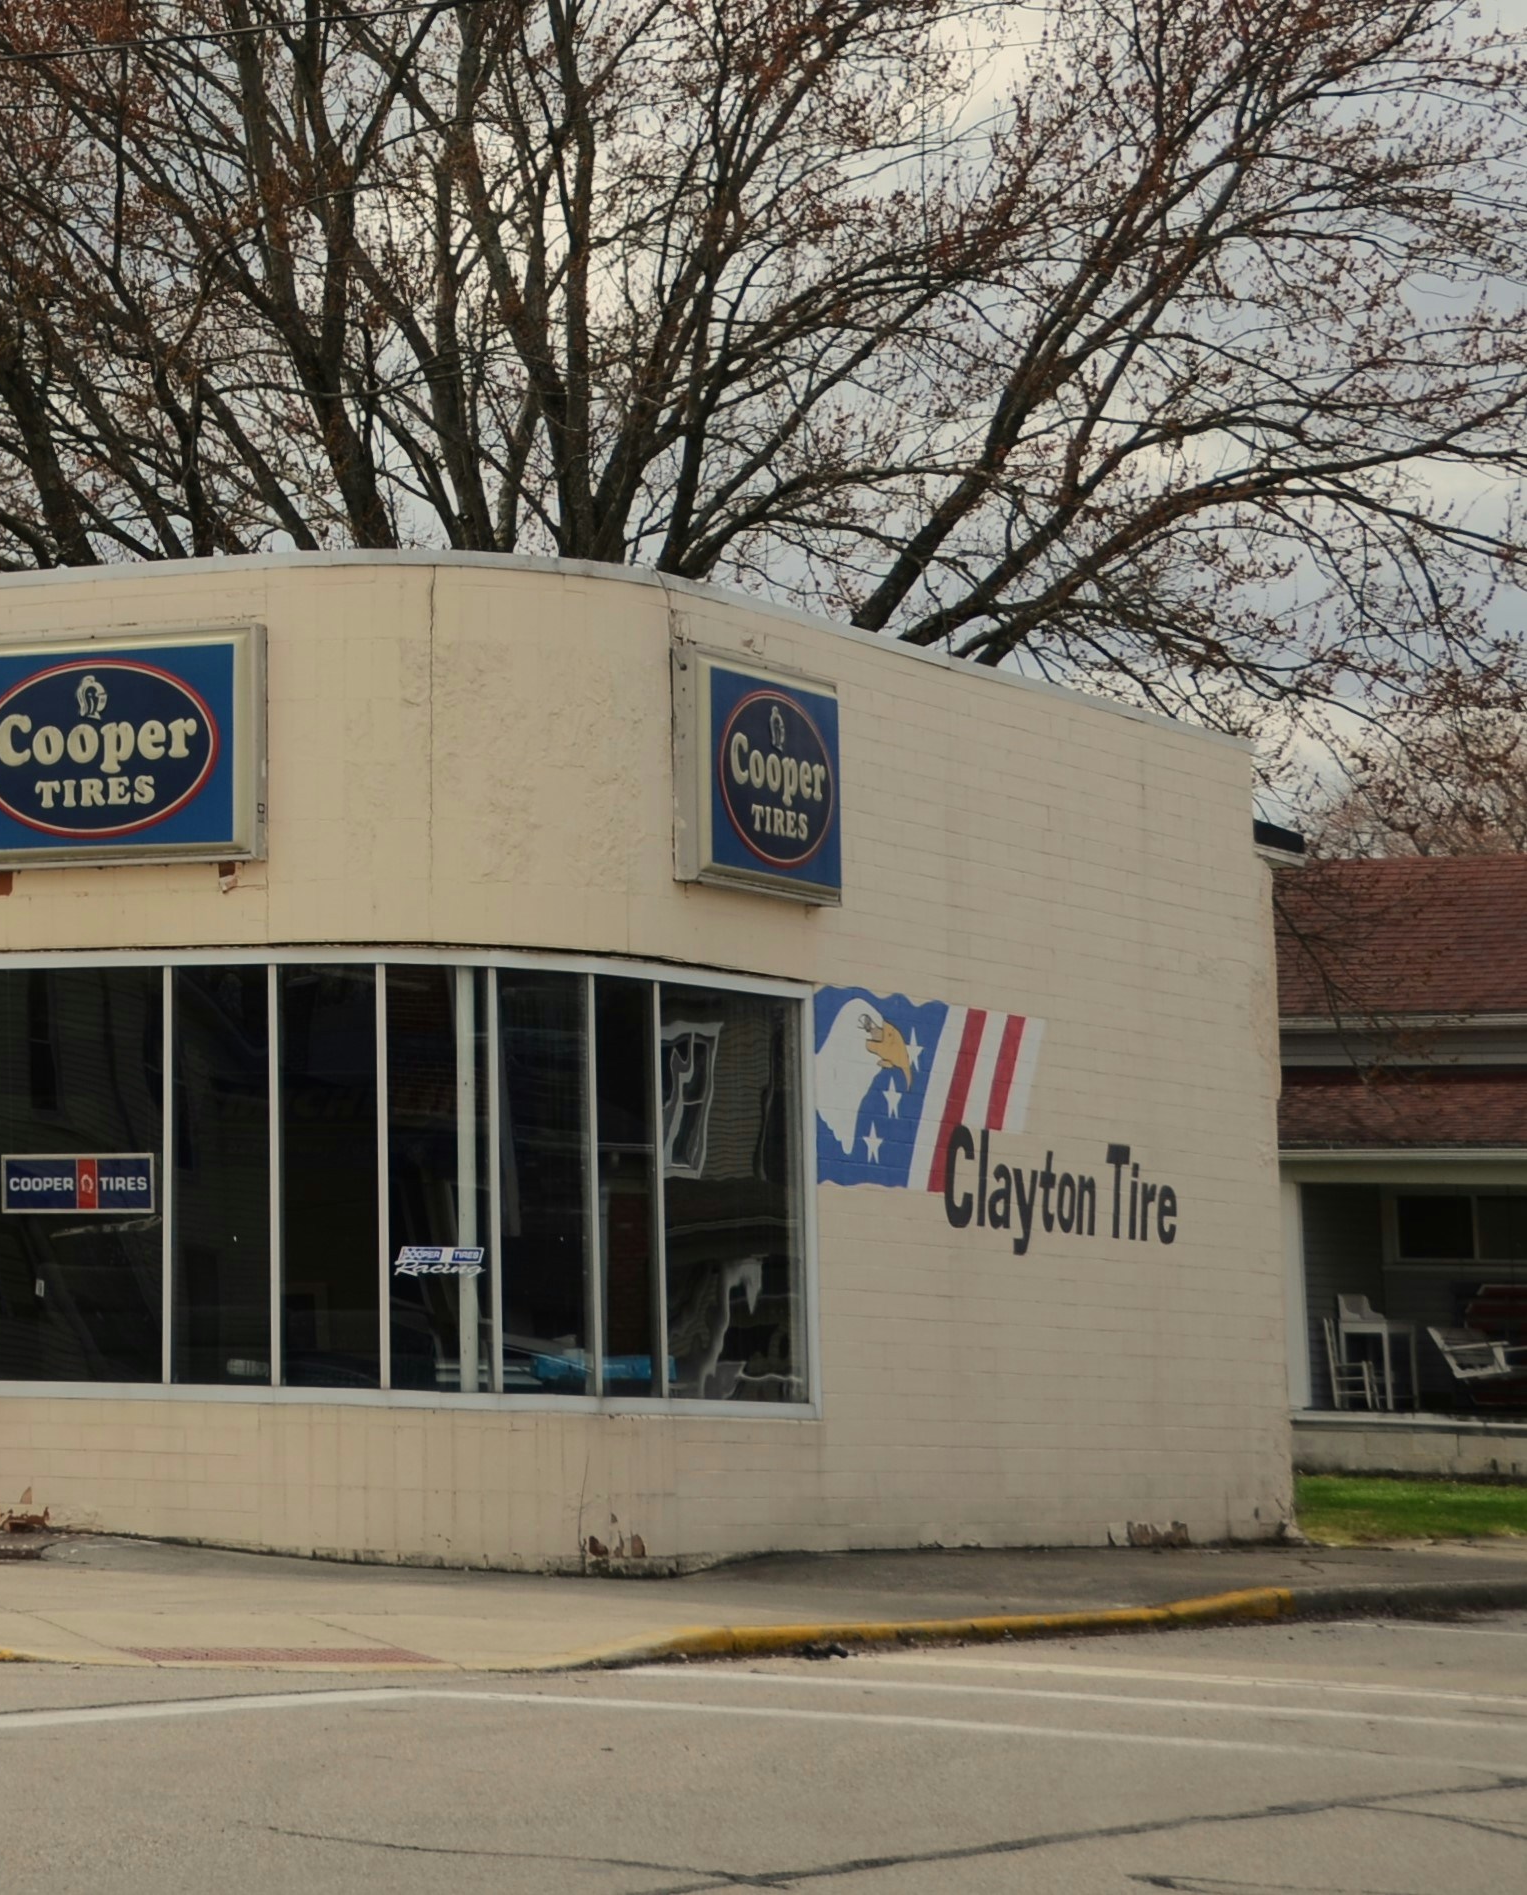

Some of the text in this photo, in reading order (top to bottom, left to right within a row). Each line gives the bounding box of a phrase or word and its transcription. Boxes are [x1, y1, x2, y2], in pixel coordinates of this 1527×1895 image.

[729, 732, 827, 804] Cooper
[35, 774, 155, 809] TIRES
[751, 803, 810, 842] TIRES
[9, 1176, 148, 1192] COOPER TIRES
[944, 1124, 1178, 1256] Clayton Tire
[394, 1260, 486, 1278] Racing
